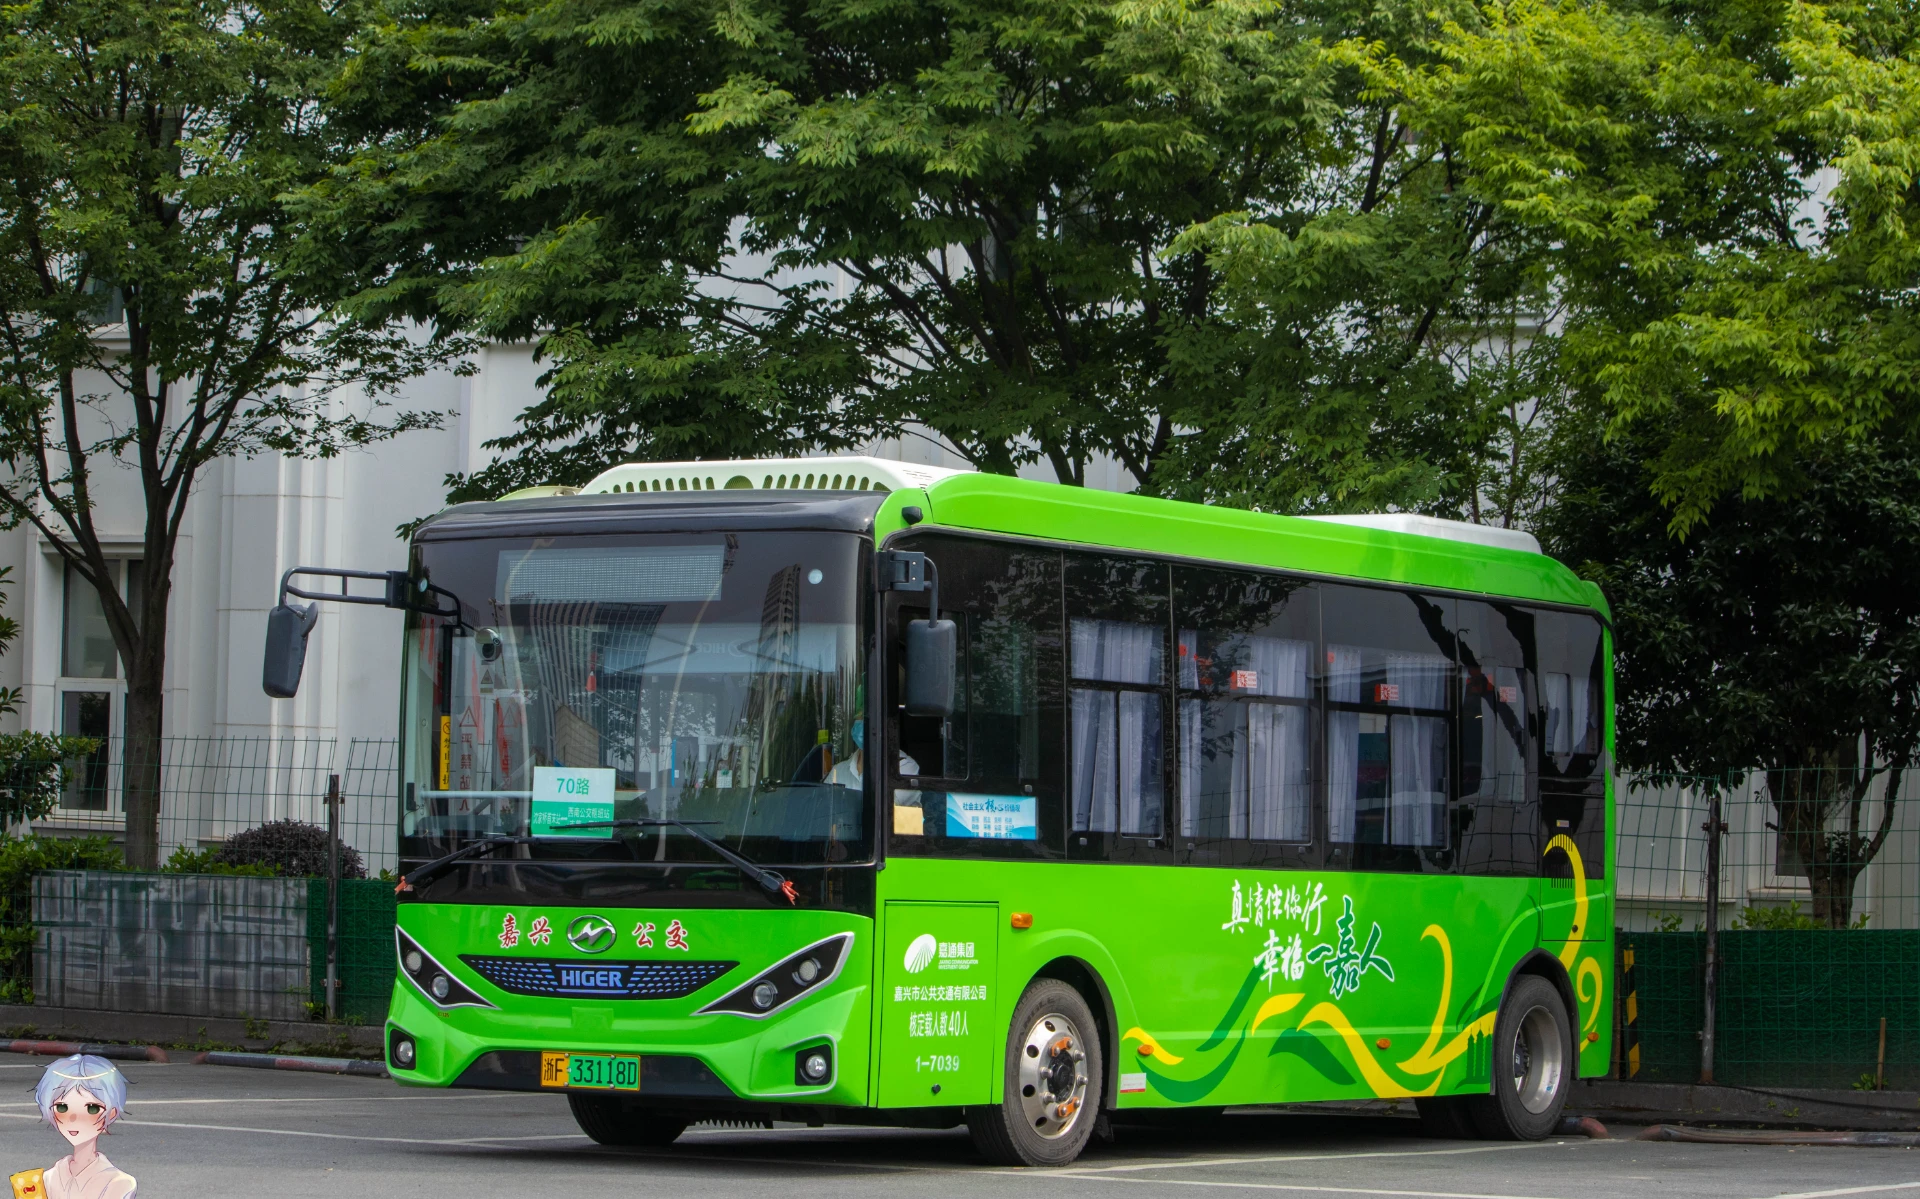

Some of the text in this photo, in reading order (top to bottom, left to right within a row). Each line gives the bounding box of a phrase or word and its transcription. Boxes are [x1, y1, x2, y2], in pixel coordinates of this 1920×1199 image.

[557, 778, 590, 795] 70路
[1222, 879, 1328, 936] 真情伴你行
[499, 913, 689, 951] 嘉兴 公交
[938, 942, 975, 958] 嘉通集团
[562, 970, 622, 987] HIGER
[894, 986, 987, 1001] 嘉兴市公共交通有限公司
[915, 1056, 960, 1072] 1-7039
